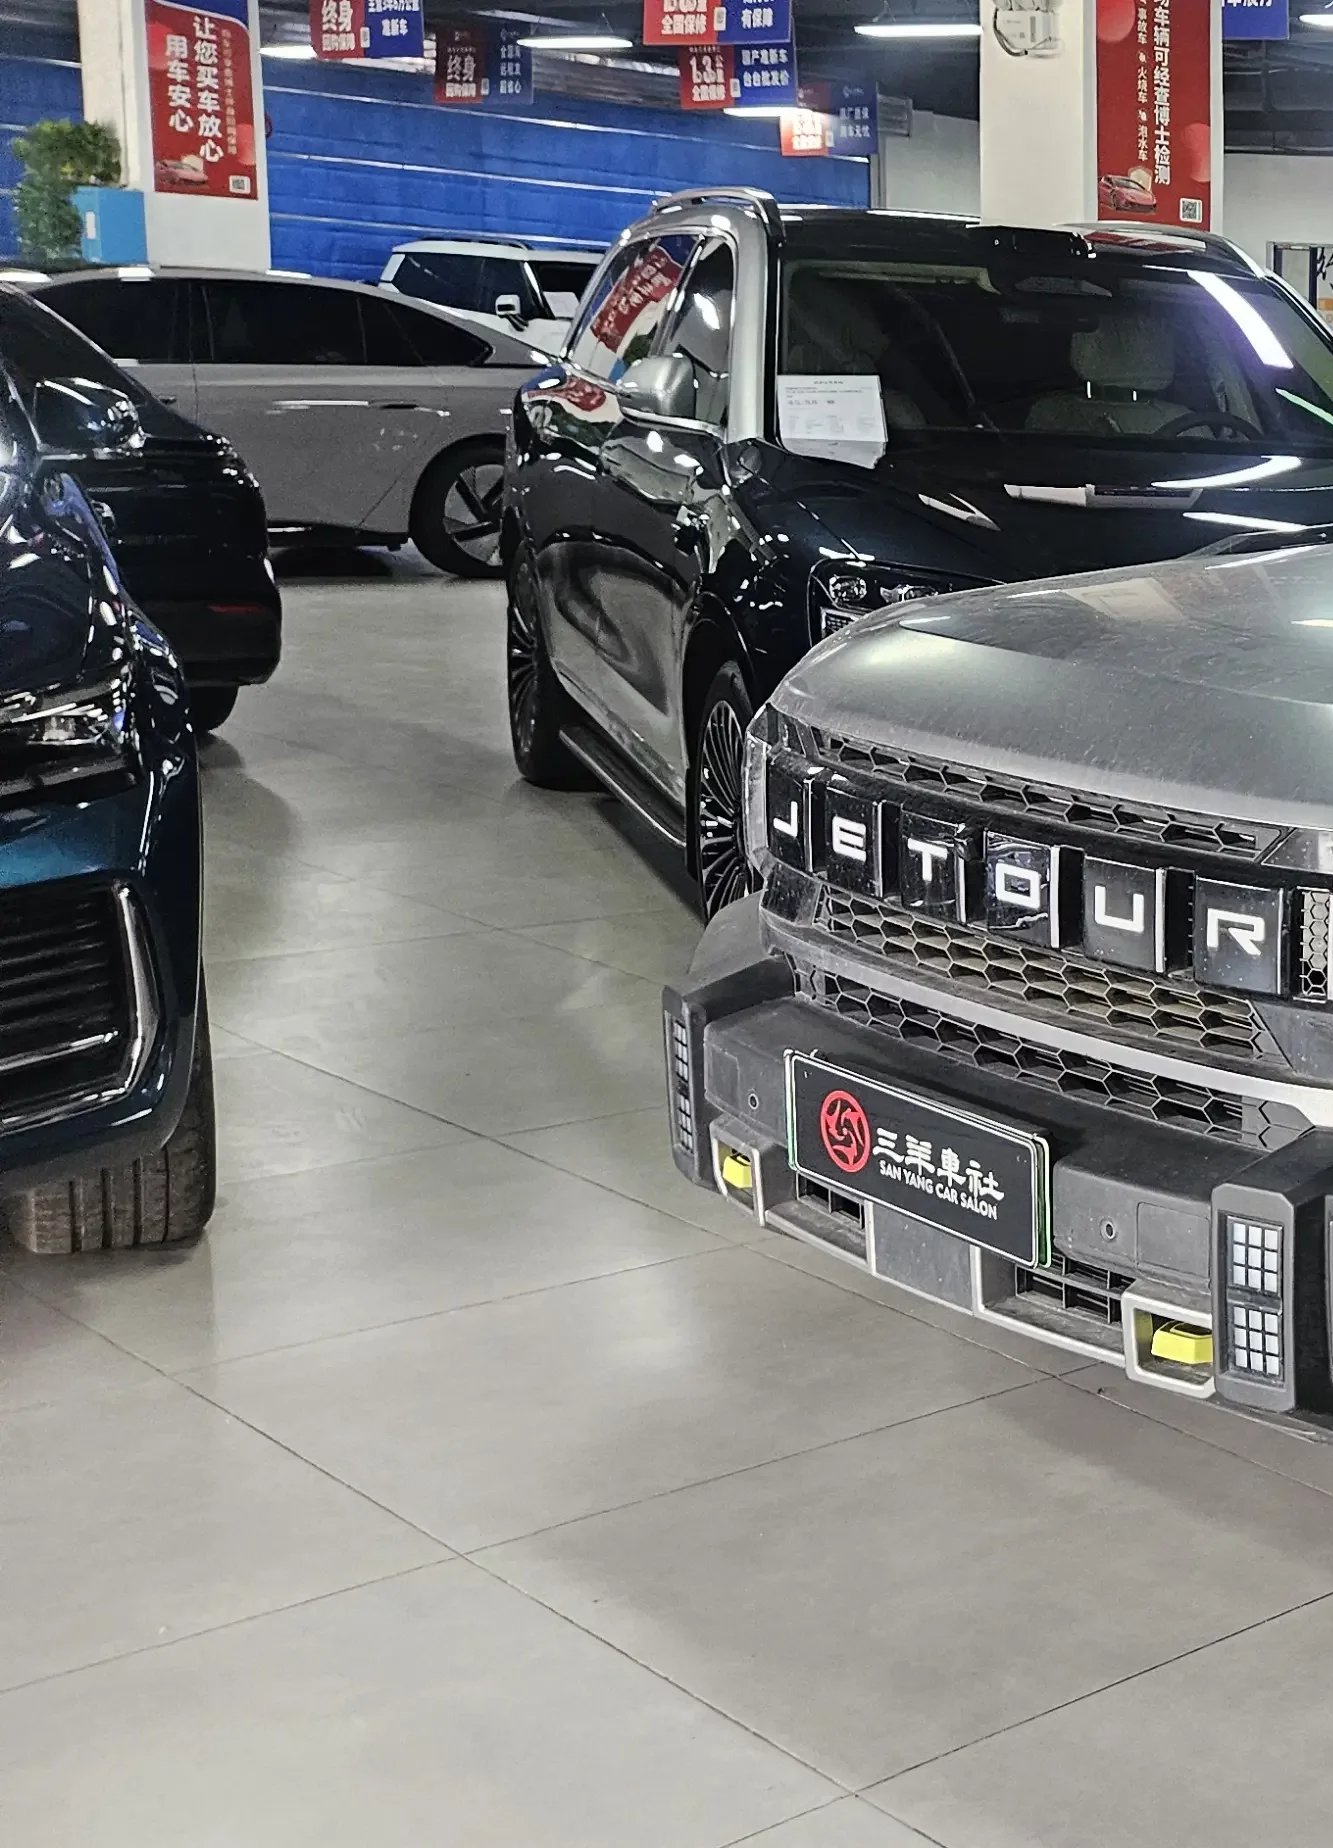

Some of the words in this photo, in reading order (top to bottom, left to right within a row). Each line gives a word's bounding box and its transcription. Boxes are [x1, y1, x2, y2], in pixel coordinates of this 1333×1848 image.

[321, 0, 354, 31] 终身
[661, 14, 707, 35] 全国保修
[165, 34, 194, 133] 用车安心
[193, 15, 224, 163] 让您买车放心
[447, 54, 476, 82] 终身
[772, 799, 1267, 957] JETOUR
[872, 1127, 1005, 1201] 三羊車社
[879, 1160, 902, 1182] SAN
[902, 1167, 933, 1195] YANG
[935, 1184, 959, 1206] CAR
[959, 1191, 999, 1221] SALON
